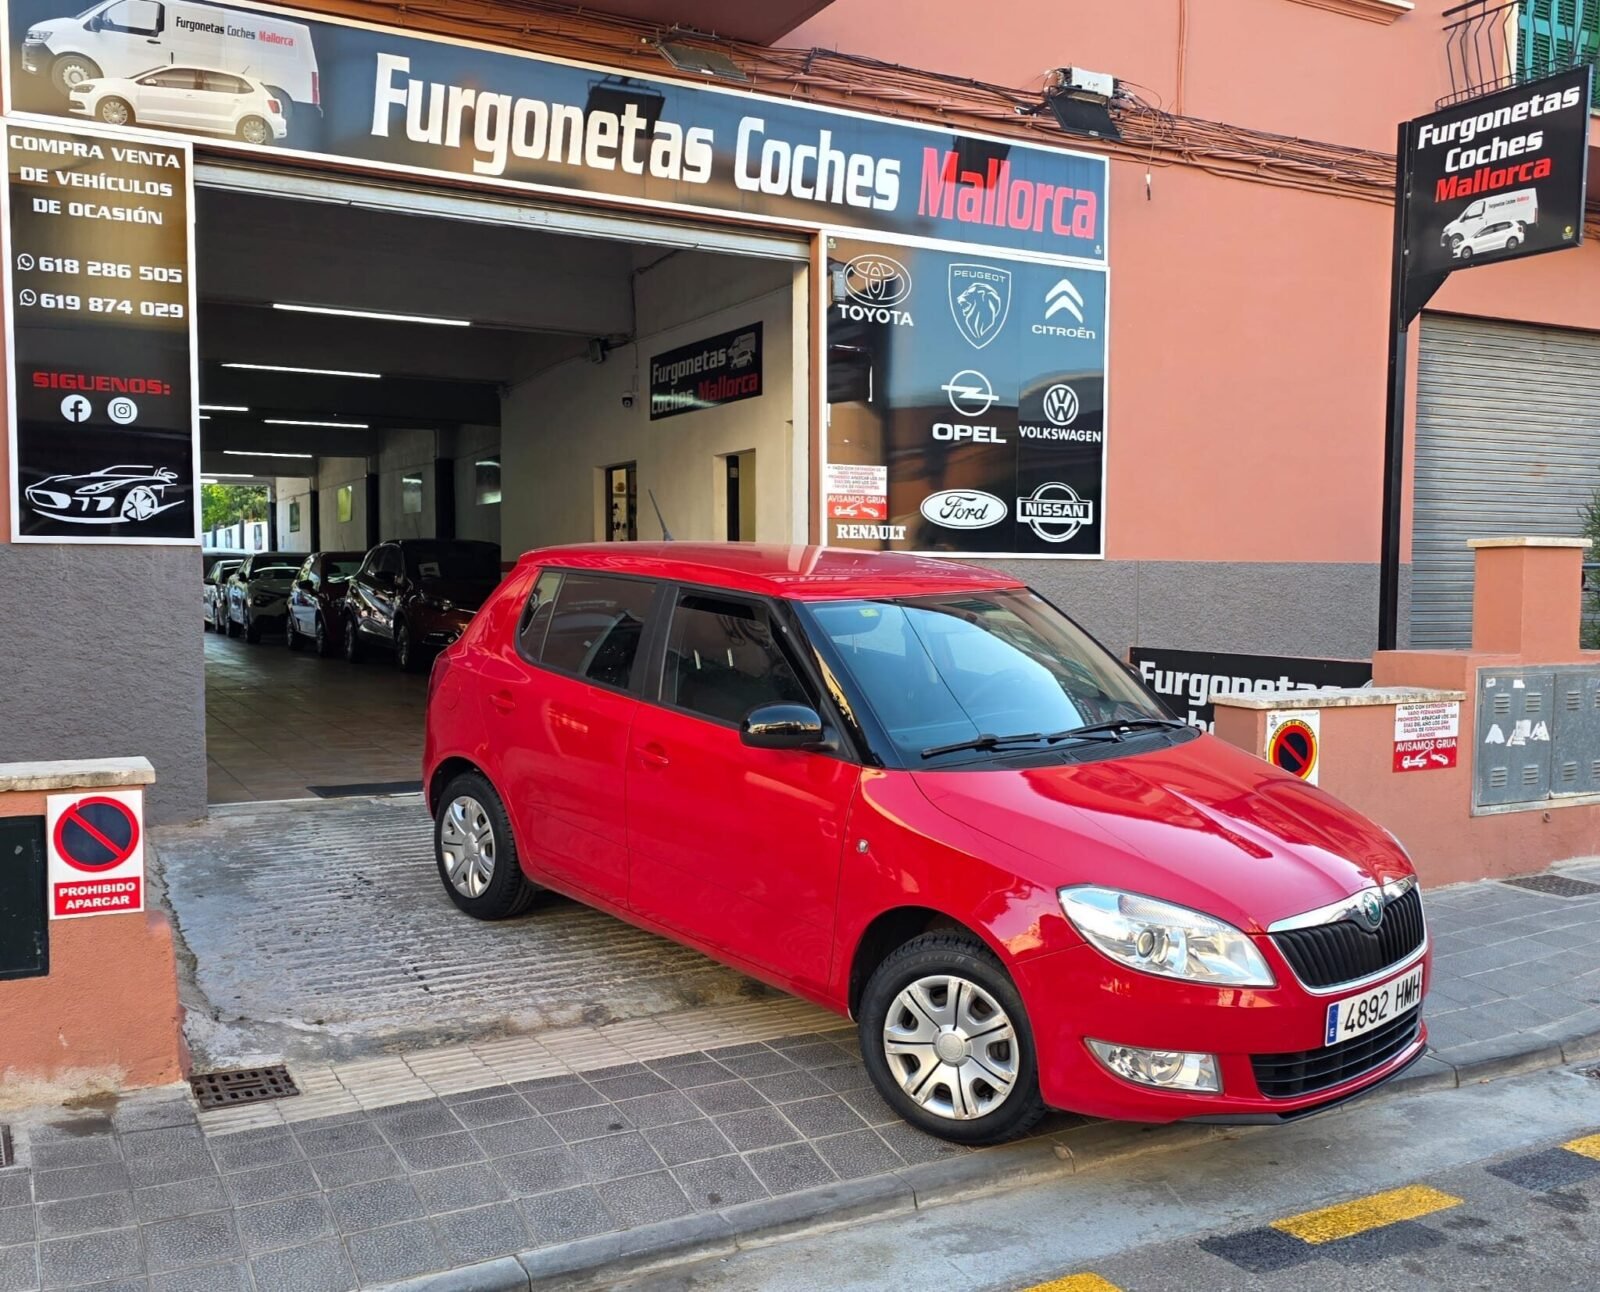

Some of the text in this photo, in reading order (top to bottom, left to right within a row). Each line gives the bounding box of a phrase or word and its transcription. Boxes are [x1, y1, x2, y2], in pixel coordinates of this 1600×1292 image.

[176, 16, 294, 46] Furgonetas Coches Mallorca
[1417, 86, 1580, 150] Furgonetas
[9, 134, 181, 169] COMPRA VENTA
[370, 52, 1097, 239] Furgonetas Coches Mallorca
[1445, 130, 1544, 173] Coches
[20, 166, 173, 197] DE VEHÍCULOS
[1434, 157, 1552, 203] Mallorca
[33, 198, 163, 225] DE OCASIÓN
[38, 257, 183, 284] 618 286 505
[953, 270, 1006, 283] PEUGEOT
[40, 293, 184, 318] 619 874 029
[838, 303, 914, 326] TOYOTA
[652, 348, 727, 385] Furgonetas
[32, 372, 171, 395] SIGUENOS:
[698, 373, 758, 401] Mallorca
[932, 422, 1007, 444] OPEL
[1018, 425, 1101, 443] VOLKSWAGEN
[827, 495, 865, 504] AVISAMOS
[939, 495, 989, 521] Ford
[1025, 503, 1084, 518] NISSAN
[836, 524, 907, 540] RENAULT
[1139, 660, 1341, 706] Furgone
[1395, 738, 1457, 753] AVISAMOS GRUA
[58, 882, 136, 897] PROHIBIDO
[65, 895, 130, 910] APARCAR
[1344, 971, 1421, 1033] 4892 HMH
